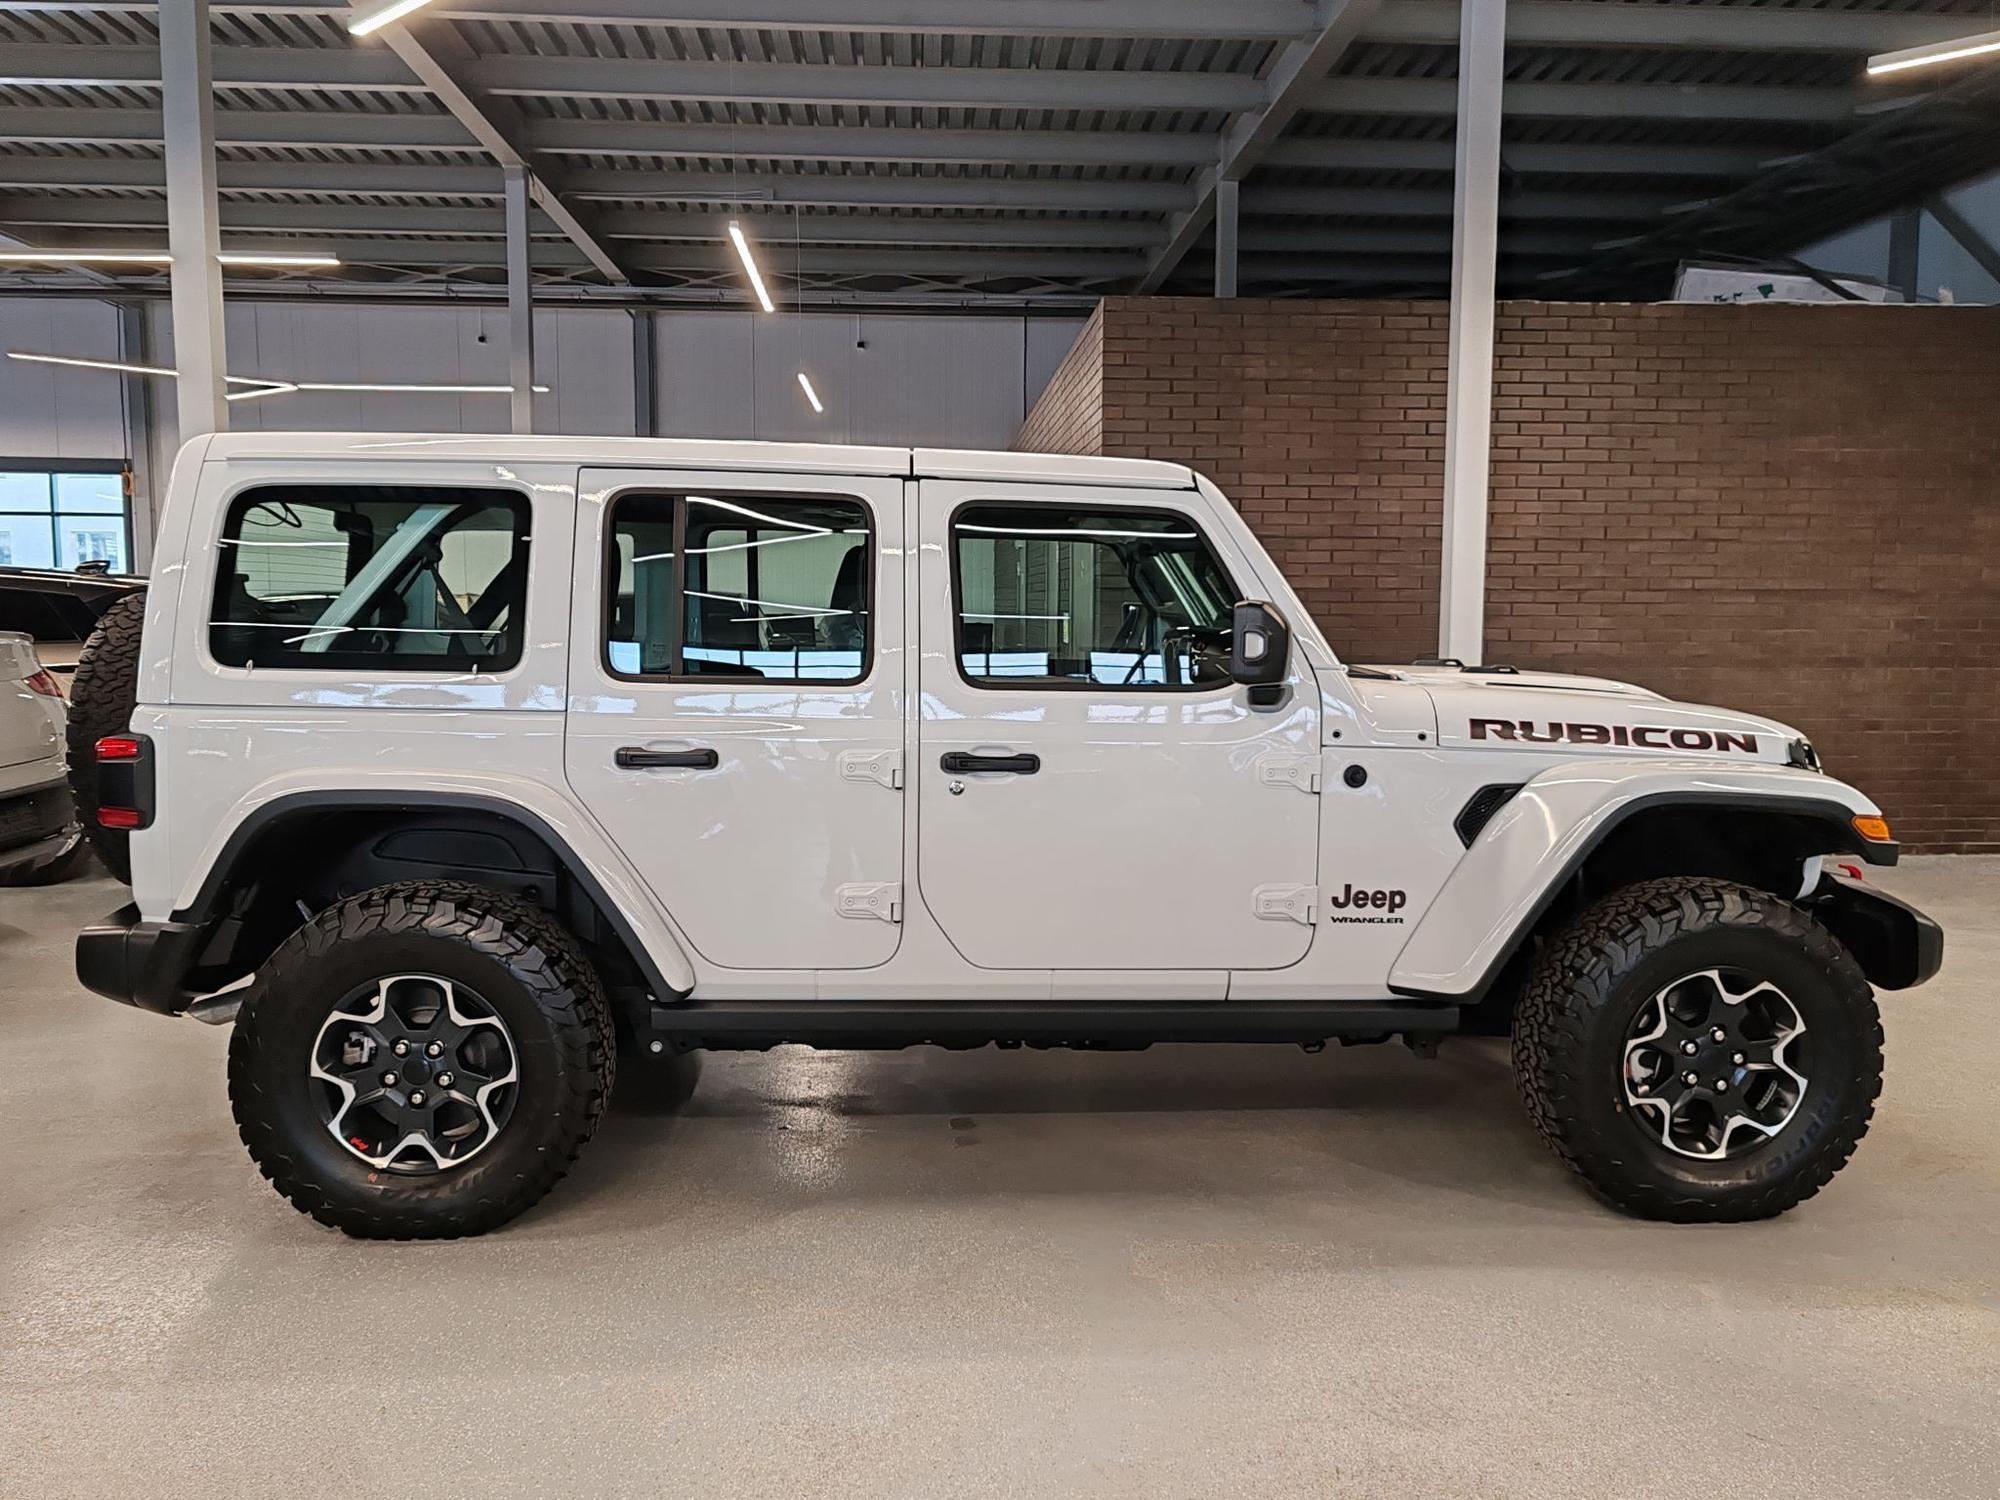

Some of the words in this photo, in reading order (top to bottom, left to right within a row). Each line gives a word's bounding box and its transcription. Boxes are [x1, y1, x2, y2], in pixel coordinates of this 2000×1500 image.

[1468, 717, 1760, 754] RUBICON
[1331, 883, 1407, 914] Jeep
[1330, 916, 1405, 925] WRANGLER
